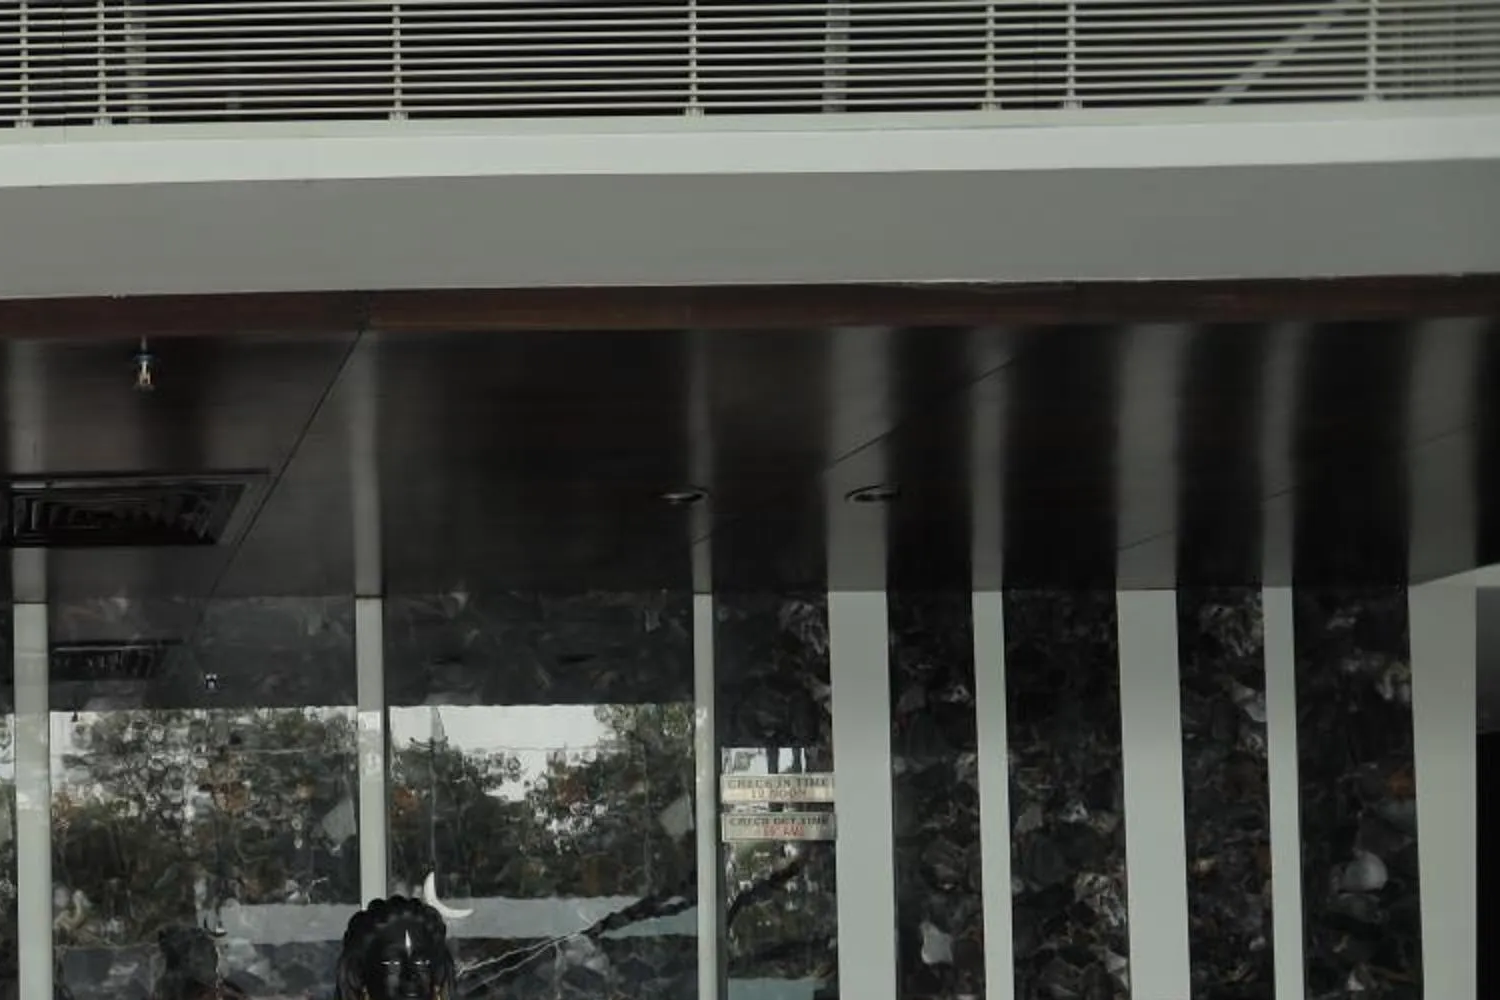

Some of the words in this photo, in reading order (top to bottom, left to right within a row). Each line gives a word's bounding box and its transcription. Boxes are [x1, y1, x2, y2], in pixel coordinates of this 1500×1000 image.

[727, 779, 771, 789] CHECK
[776, 779, 791, 788] IN
[796, 777, 829, 787] TIME
[729, 817, 770, 826] CHECK
[801, 816, 830, 825] TIME
